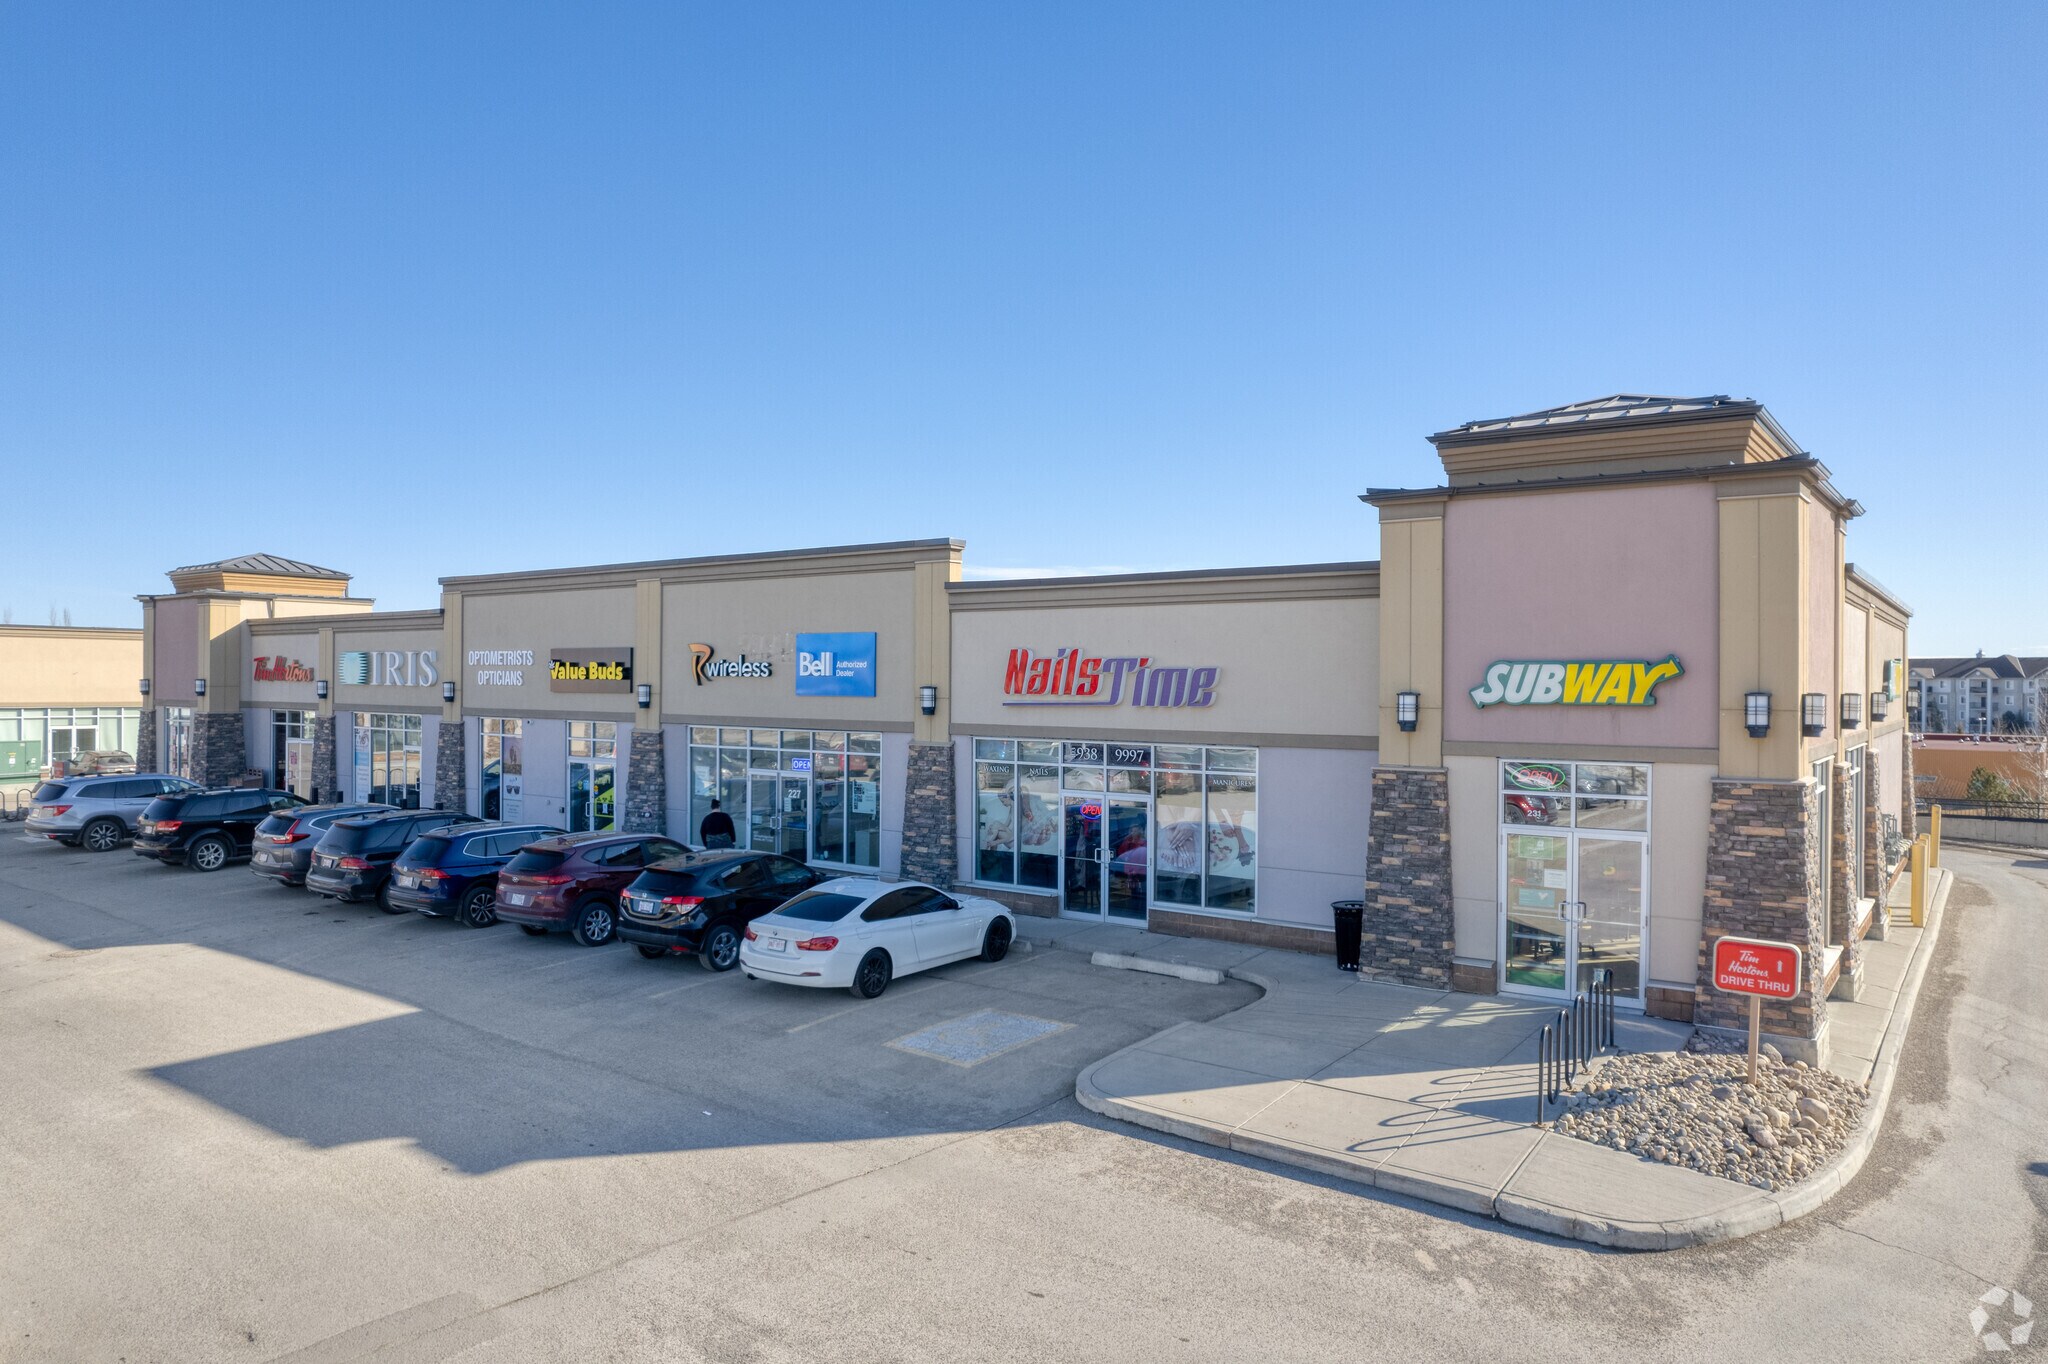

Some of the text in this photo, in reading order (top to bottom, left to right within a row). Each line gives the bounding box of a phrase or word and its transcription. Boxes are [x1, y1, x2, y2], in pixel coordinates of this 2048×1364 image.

[468, 650, 533, 666] OPTOMETRISTS
[799, 651, 834, 677] Bell
[836, 660, 868, 669] Authorized
[370, 650, 438, 687] IRIS
[550, 661, 624, 681] Value Buds
[835, 669, 855, 678] Dealer
[477, 670, 523, 686] OPTICIANS
[1470, 659, 1680, 706] SUBWAY
[1115, 748, 1144, 763] 9997
[984, 765, 1010, 774] WAXING
[1029, 767, 1049, 776] NAILS
[1516, 769, 1559, 785] OPEN
[1212, 779, 1252, 788] MANICURES
[788, 789, 801, 799] 227
[1081, 804, 1103, 816] OPEN
[1527, 810, 1541, 818] 231
[1739, 950, 1759, 964] Tim
[1728, 960, 1769, 977] Hortons
[1720, 974, 1790, 993] DRIVE THRU
